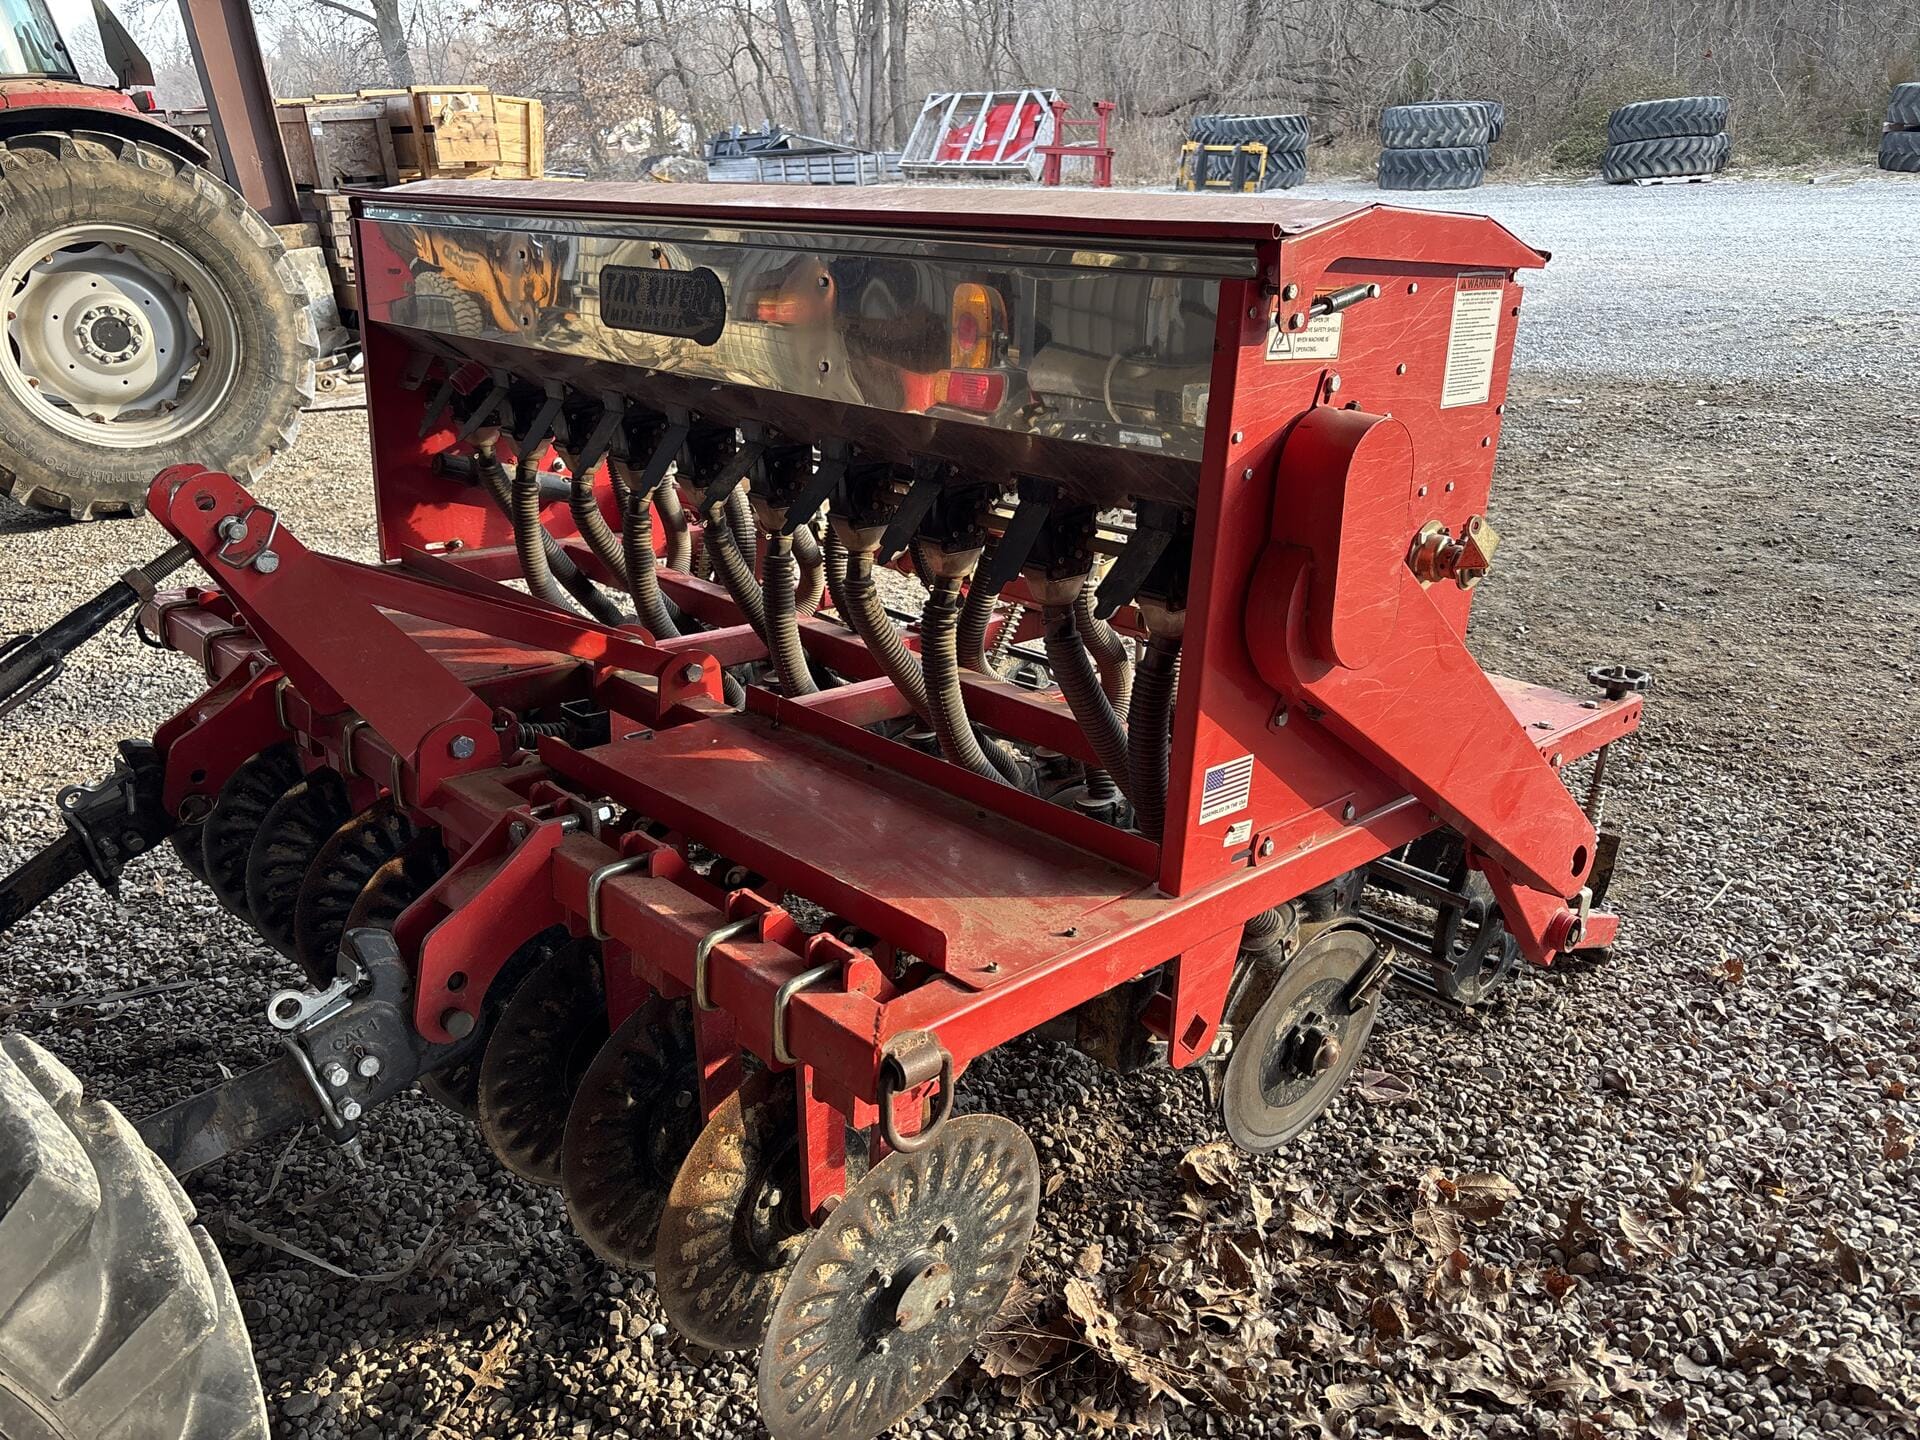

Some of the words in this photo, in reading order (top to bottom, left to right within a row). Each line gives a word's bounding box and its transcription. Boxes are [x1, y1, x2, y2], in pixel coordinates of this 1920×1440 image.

[605, 271, 641, 305] TAR
[647, 275, 707, 314] RIVER
[1467, 278, 1502, 288] WARNING
[604, 303, 685, 328] IMPLEMENTS
